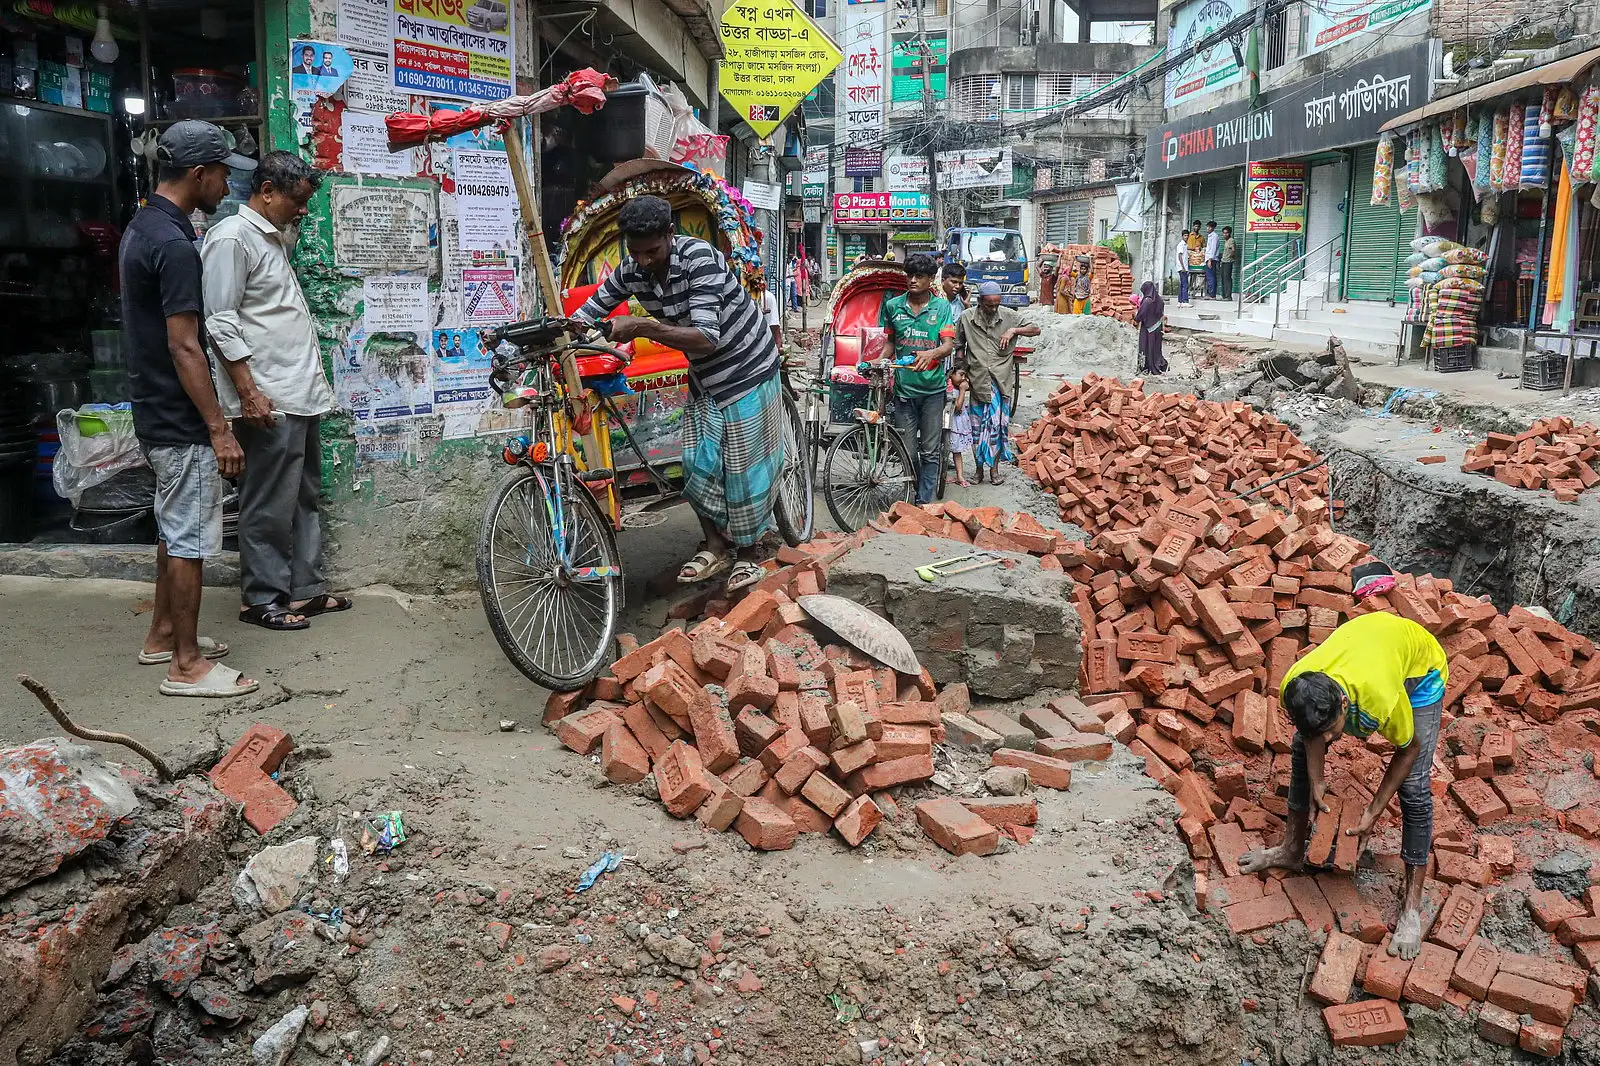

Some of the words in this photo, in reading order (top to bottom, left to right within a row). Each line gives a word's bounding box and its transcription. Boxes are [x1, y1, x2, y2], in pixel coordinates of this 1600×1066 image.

[735, 5, 758, 24] স্বপ্ন
[763, 7, 795, 21] এখন
[398, 15, 424, 41] শিখুন
[427, 25, 486, 49] আত্মবিশ্বাসের
[488, 36, 508, 54] সঙ্গে
[720, 21, 751, 40] উত্তর
[755, 27, 809, 41] বাড্ডা-এ
[725, 48, 741, 58] -২৮,
[744, 47, 777, 60] হাজীপাড়া
[780, 48, 805, 60] মসজিদ
[720, 60, 745, 72] জীপাড়া
[747, 62, 765, 71] জামে
[768, 61, 793, 72] মসজিদ
[398, 71, 457, 93] 01690-278011,
[459, 80, 509, 99] 01345-752767
[733, 72, 751, 83] উত্তর
[779, 75, 795, 84] ঢাকা
[848, 85, 881, 104] বাংলা
[1304, 91, 1336, 129] চায়না
[1339, 74, 1411, 120] প্যাভিলিয়ন
[848, 110, 880, 124] মডেল
[1178, 126, 1215, 158] CHINA
[1216, 109, 1273, 149] PAVILION
[457, 184, 509, 197] 01904269479
[852, 197, 876, 206] Pizza
[879, 196, 886, 206] &
[889, 196, 916, 206] Momo
[371, 281, 393, 290] সাবলেট
[395, 282, 409, 291] ভাড়া
[410, 282, 421, 290] হবে
[1344, 1010, 1387, 1029] JAB
